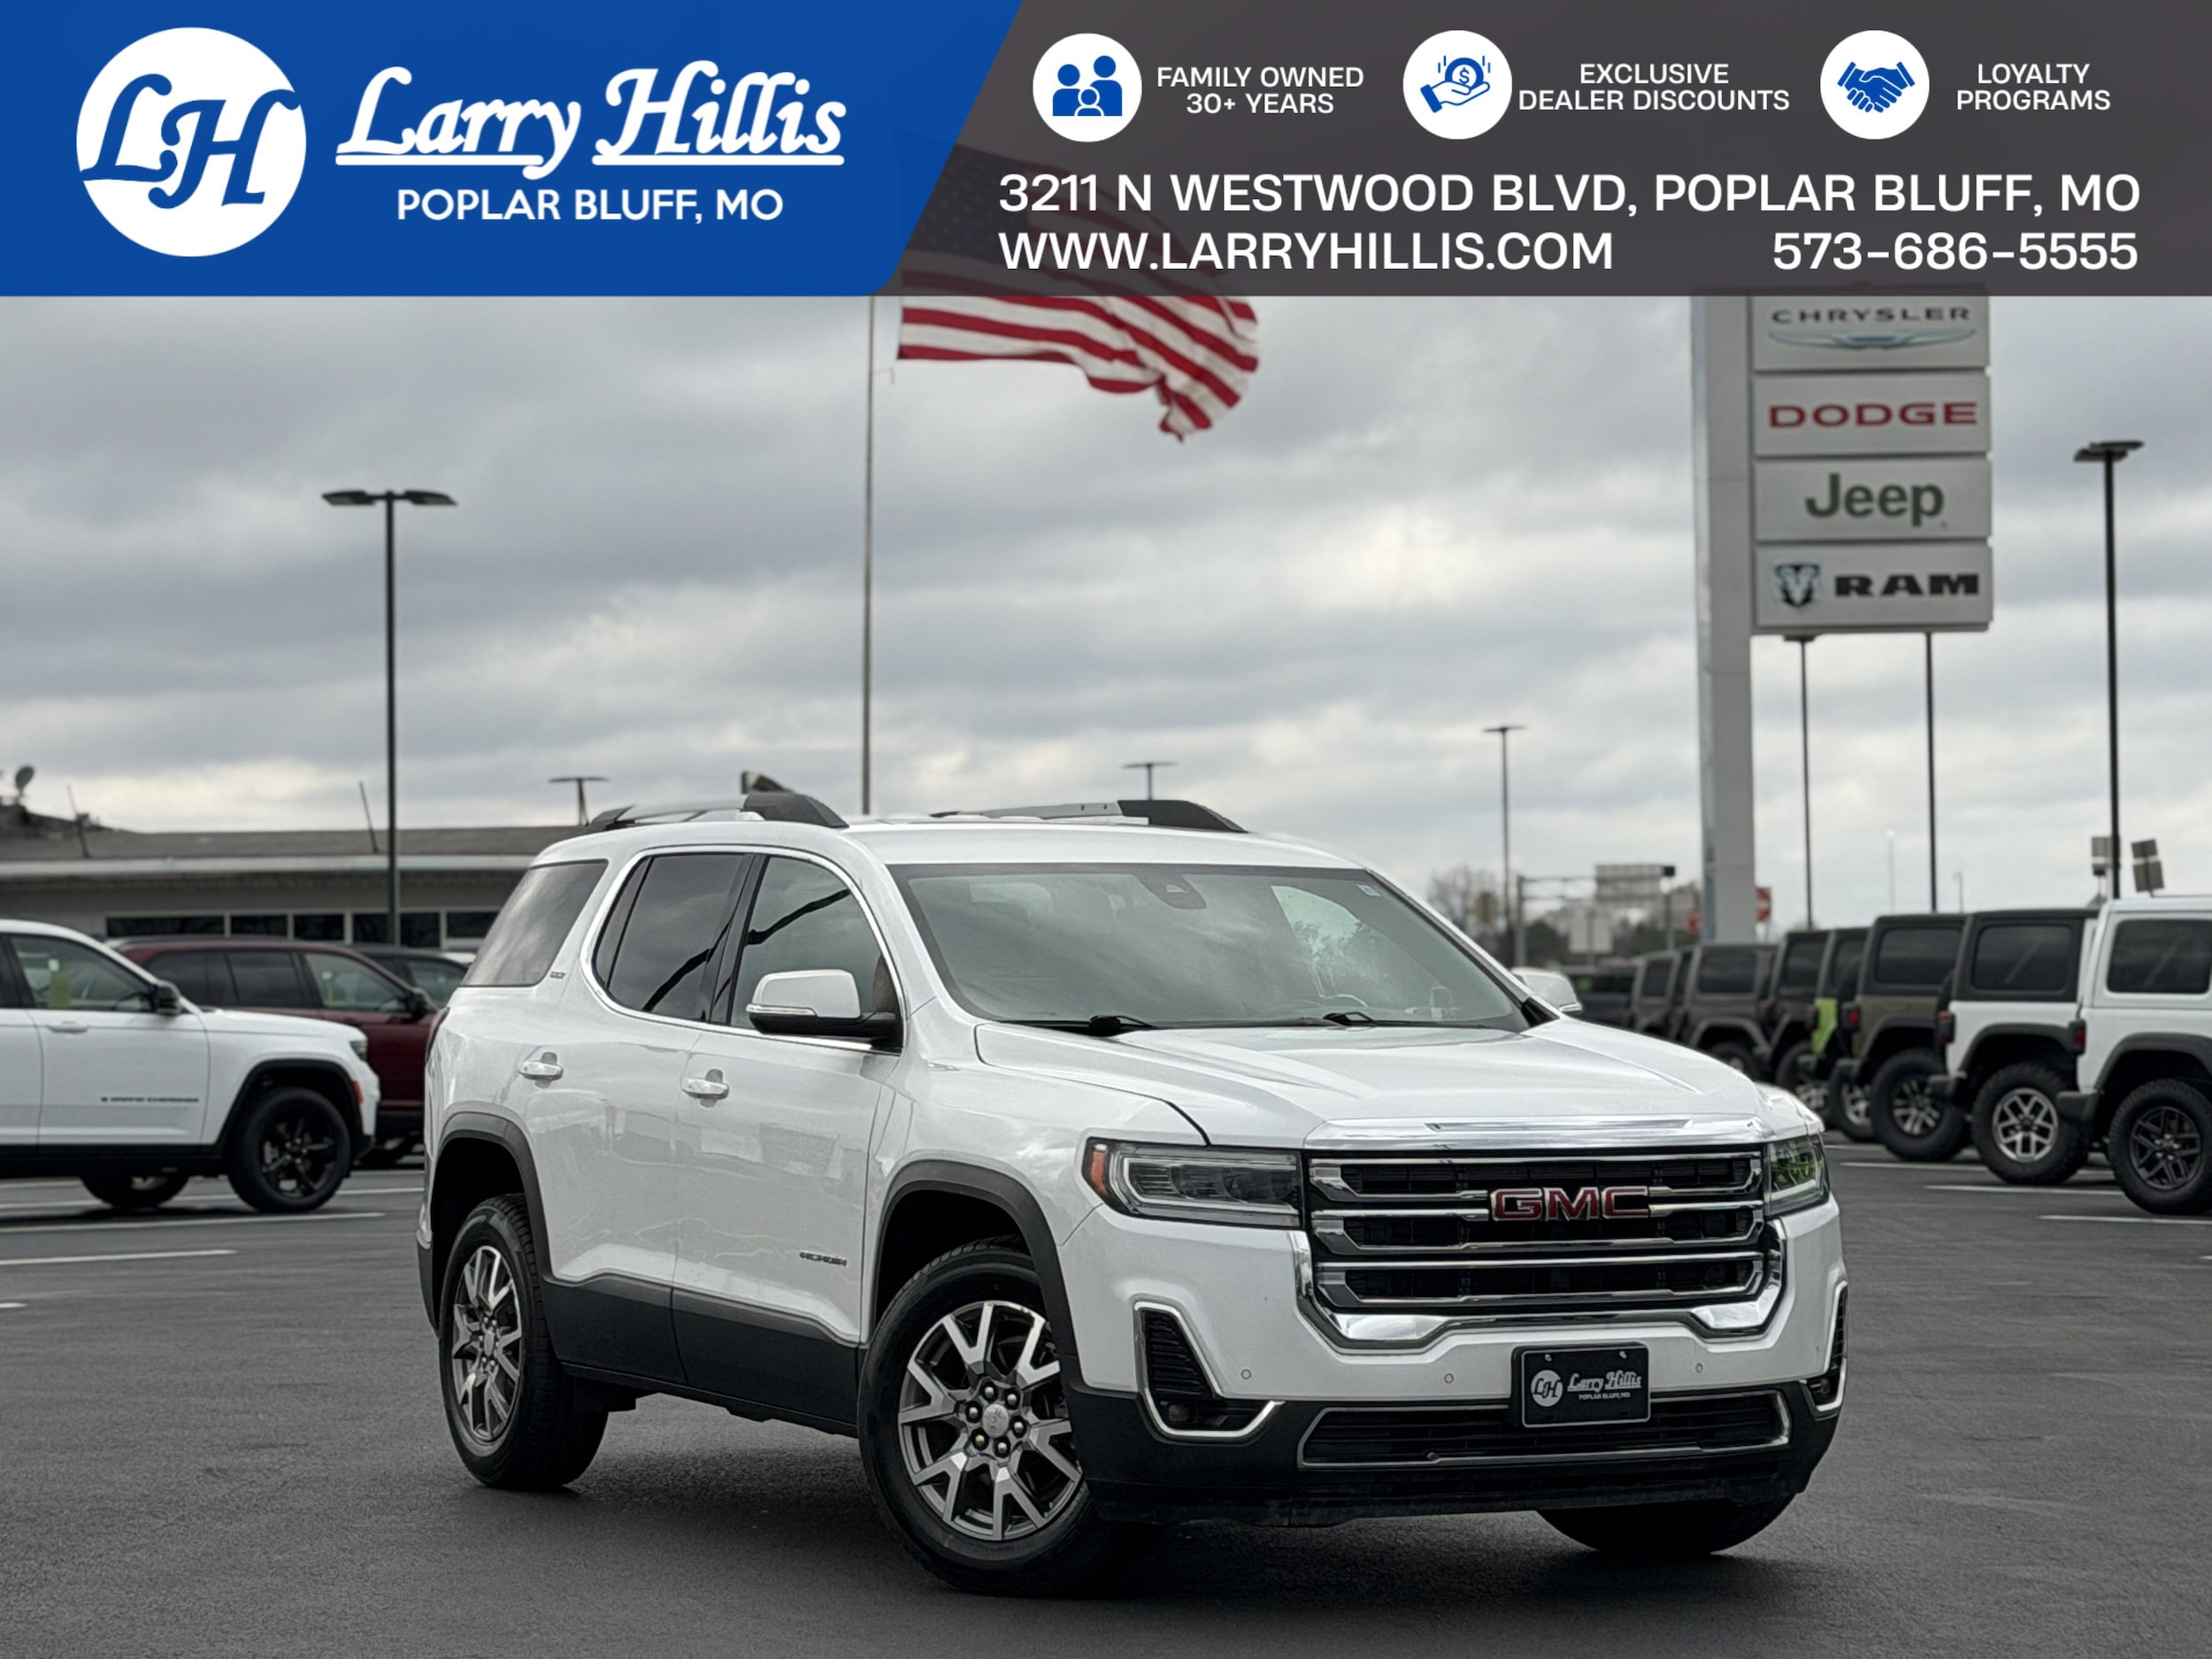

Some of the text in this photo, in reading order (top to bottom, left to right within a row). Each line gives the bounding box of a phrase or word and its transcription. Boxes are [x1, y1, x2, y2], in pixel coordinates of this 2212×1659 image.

[1771, 307, 1970, 324] CHRYSLER
[1769, 402, 1978, 428] DODGE
[1804, 472, 1945, 527] Jeep
[1834, 573, 1980, 597] RAM
[1491, 1186, 1648, 1221] GMC
[1566, 1372, 1604, 1393] Larry
[1604, 1369, 1642, 1390] Hillis
